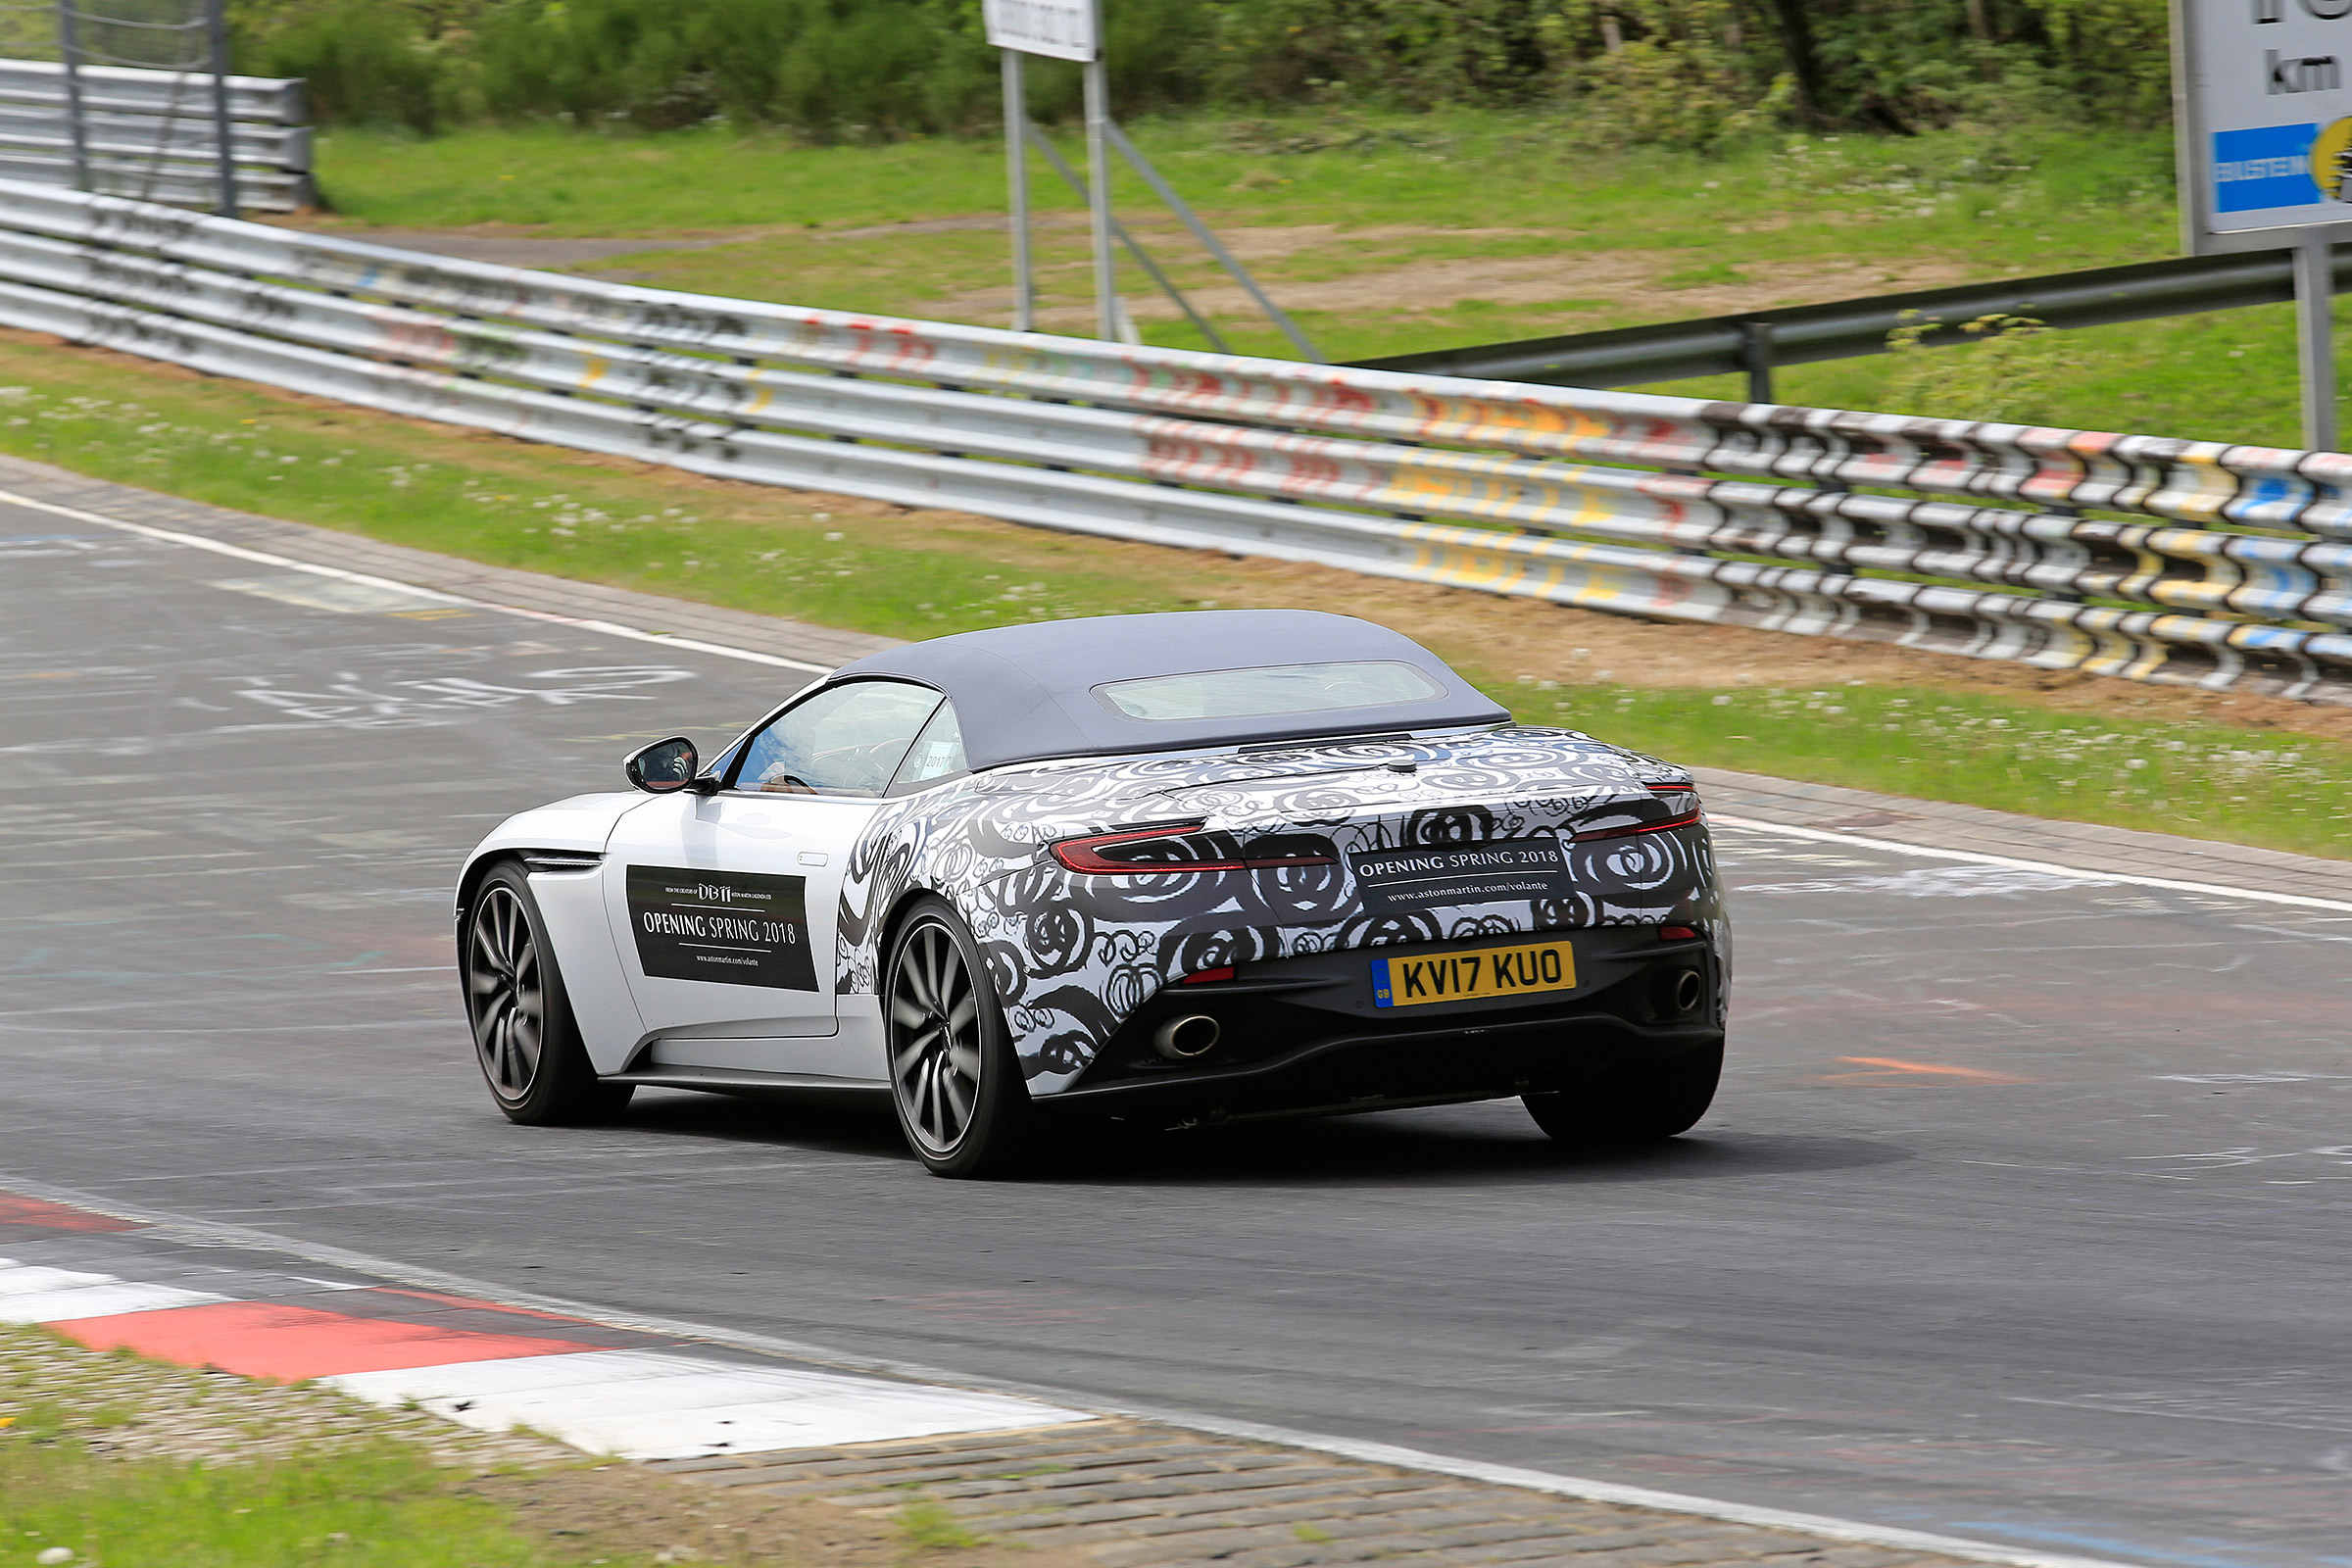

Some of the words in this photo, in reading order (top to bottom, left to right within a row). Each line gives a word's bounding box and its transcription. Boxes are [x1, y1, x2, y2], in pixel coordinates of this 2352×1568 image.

[2266, 49, 2341, 95] km
[1359, 856, 1445, 877] OPENING
[1450, 851, 1513, 868] SPRING
[1518, 850, 1559, 863] 2018
[698, 883, 731, 903] DB11
[1387, 880, 1548, 903] www.astonmartin.com/volante
[643, 911, 706, 938] OPENING
[709, 916, 760, 942] SPRING
[762, 921, 796, 945] 2018
[1402, 956, 1482, 999] KV17
[1493, 949, 1562, 989] KUO
[1377, 988, 1391, 1000] GB
